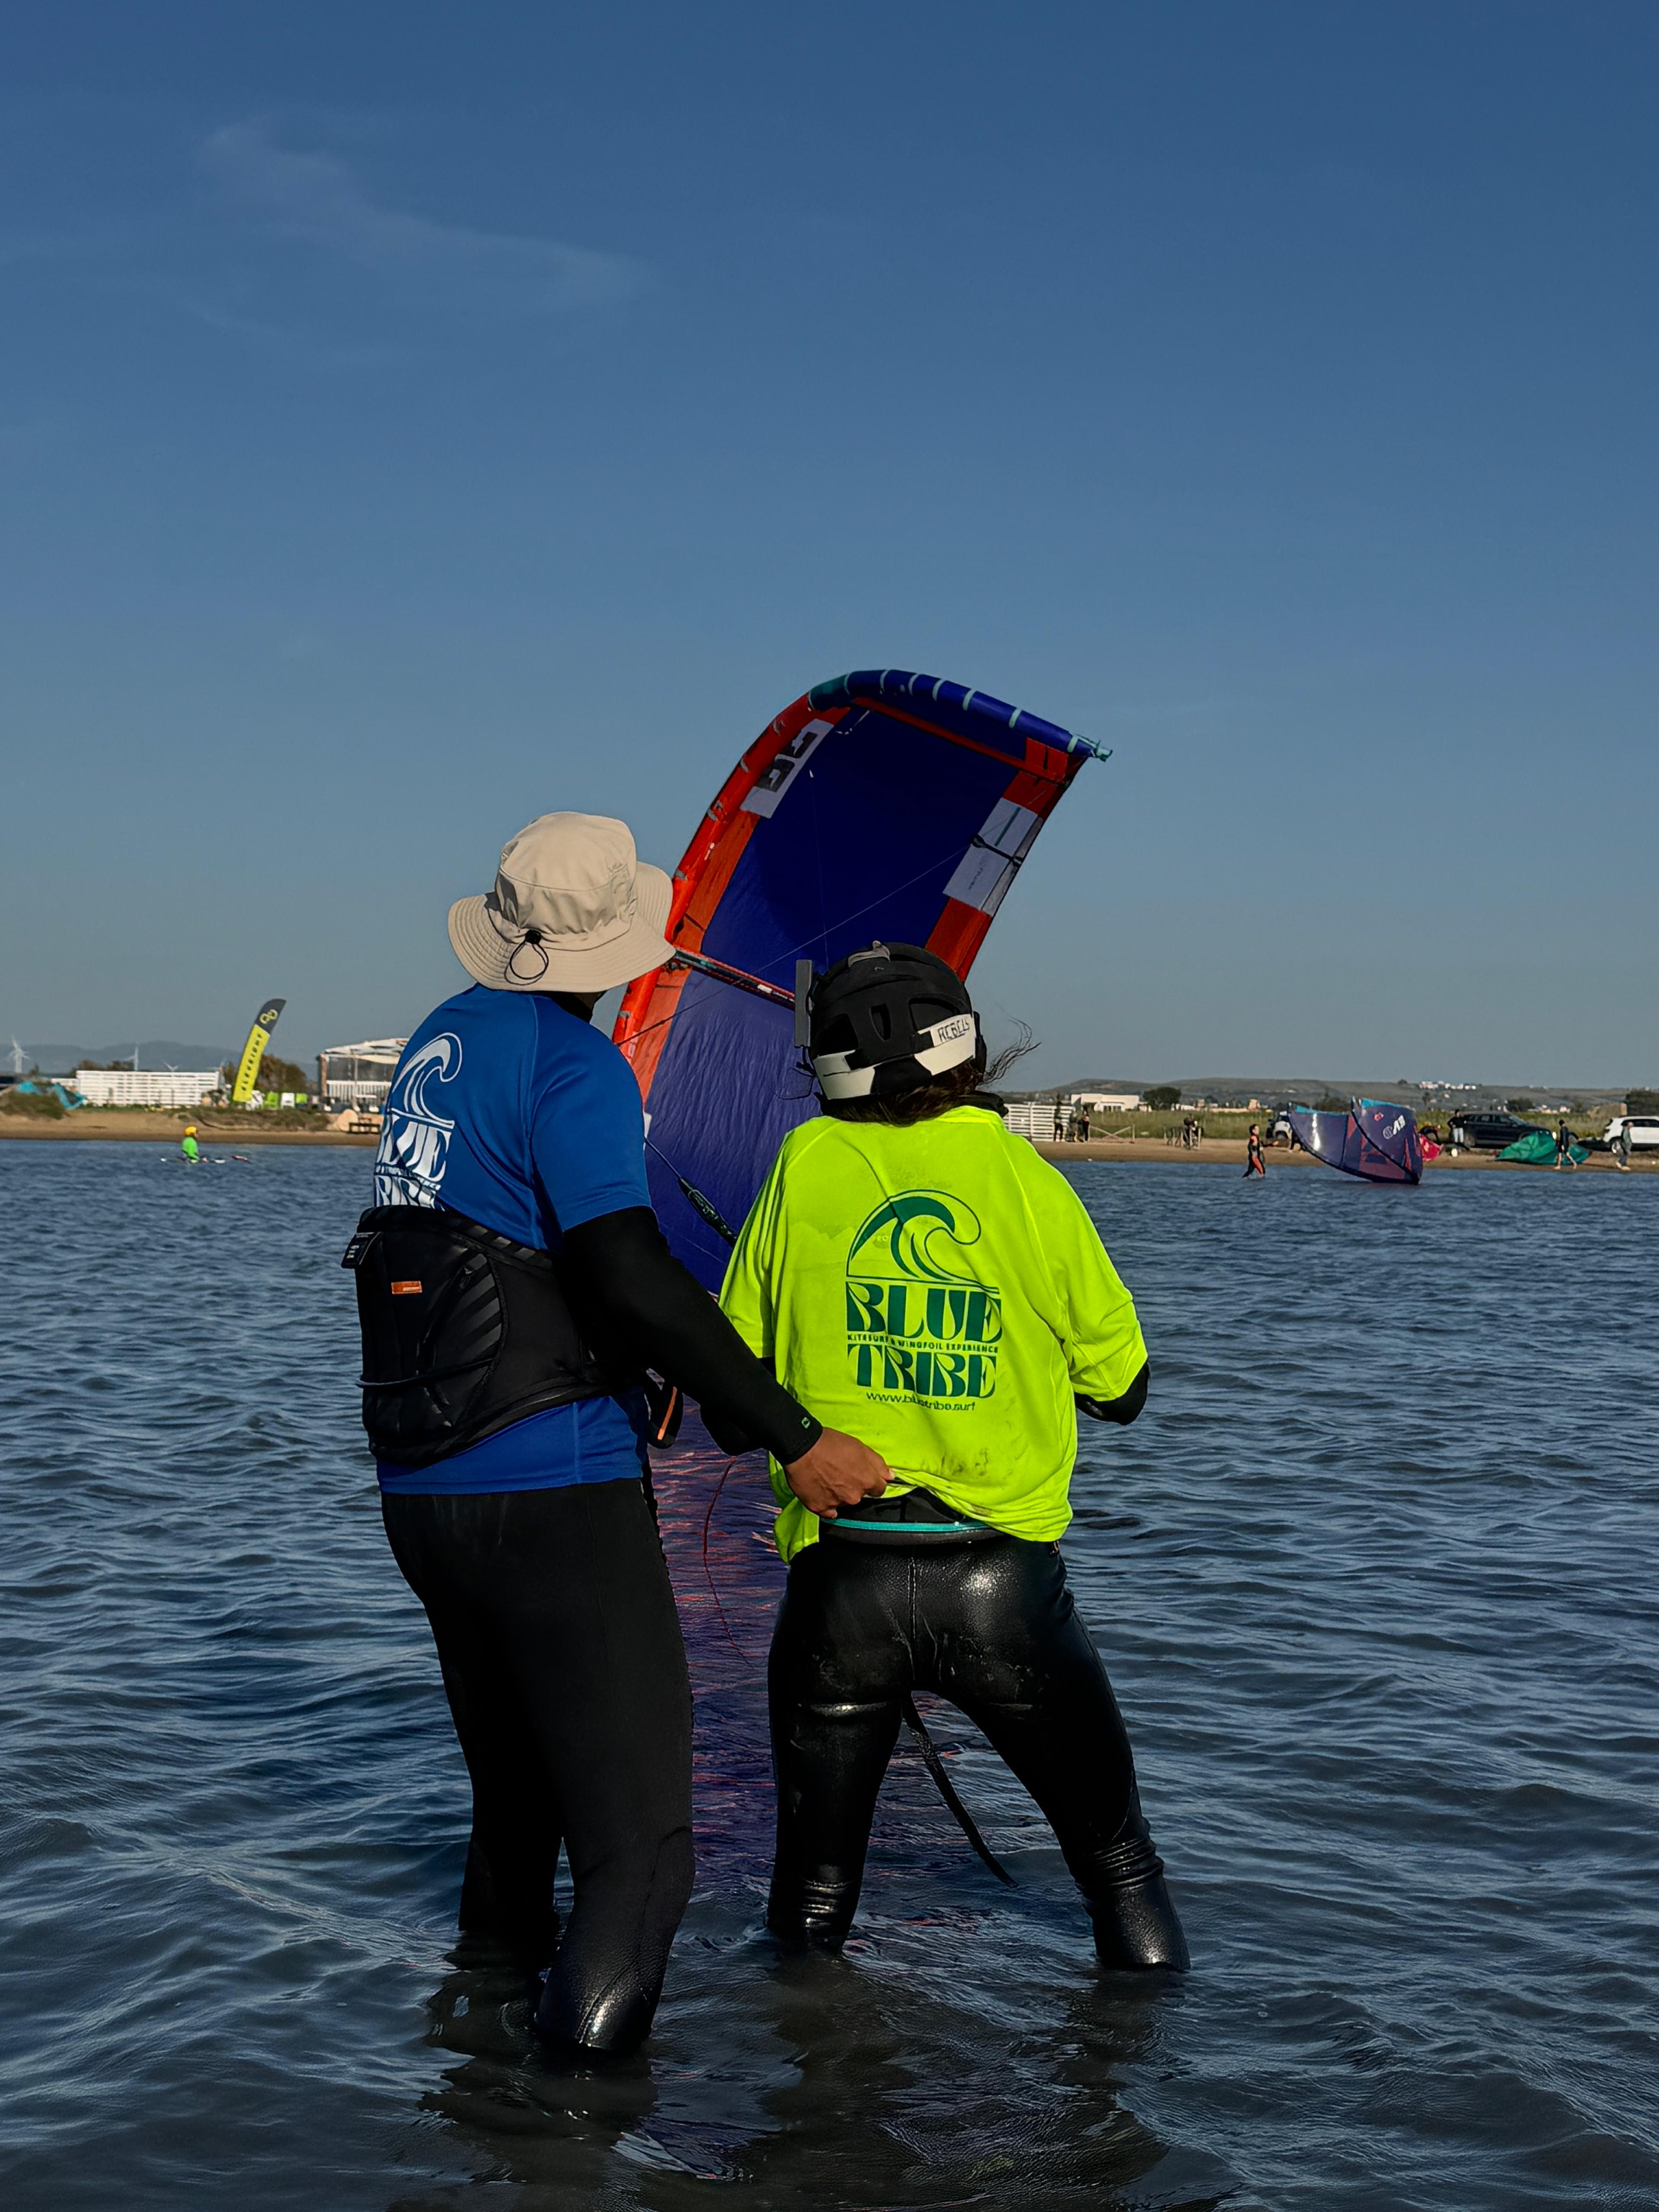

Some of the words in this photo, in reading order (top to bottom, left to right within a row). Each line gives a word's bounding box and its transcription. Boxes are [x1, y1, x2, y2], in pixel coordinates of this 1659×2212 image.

[845, 1281, 1003, 1344] BLUE
[847, 1343, 996, 1398] TRIBE
[898, 1340, 944, 1350] WINGFOIL
[946, 1343, 998, 1353] EXPERIENCE
